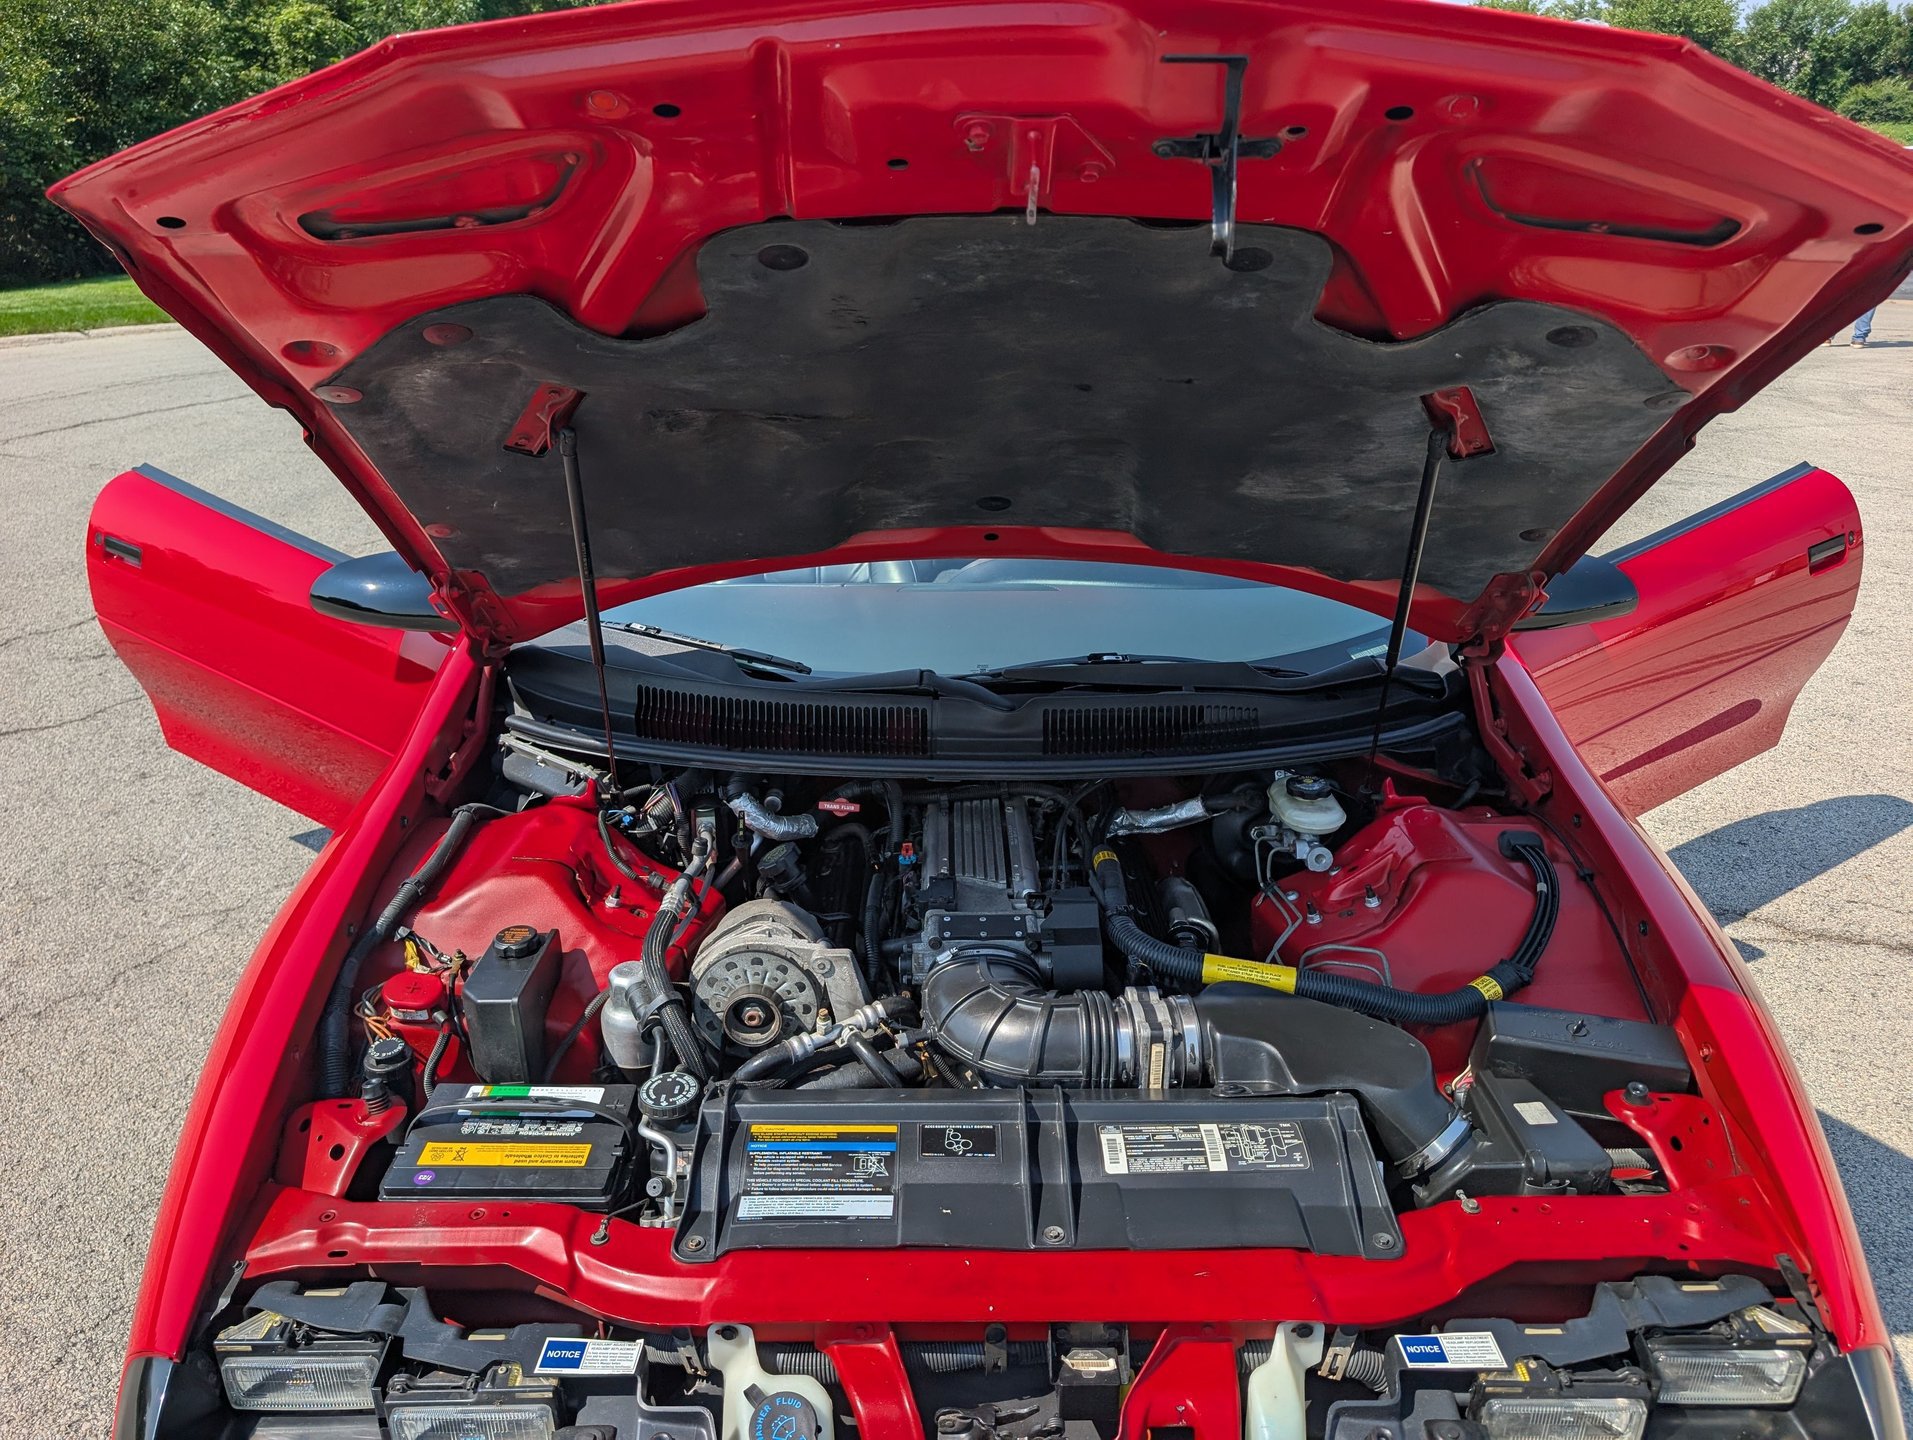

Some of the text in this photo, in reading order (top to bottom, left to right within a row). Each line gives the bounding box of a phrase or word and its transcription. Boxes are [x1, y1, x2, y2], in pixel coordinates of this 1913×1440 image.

[1487, 989, 1501, 999] FUEL
[539, 1157, 564, 1165] warranty
[1406, 1345, 1441, 1353] NOTICE
[546, 1350, 581, 1358] NOTICE
[775, 1397, 802, 1409] FLUID
